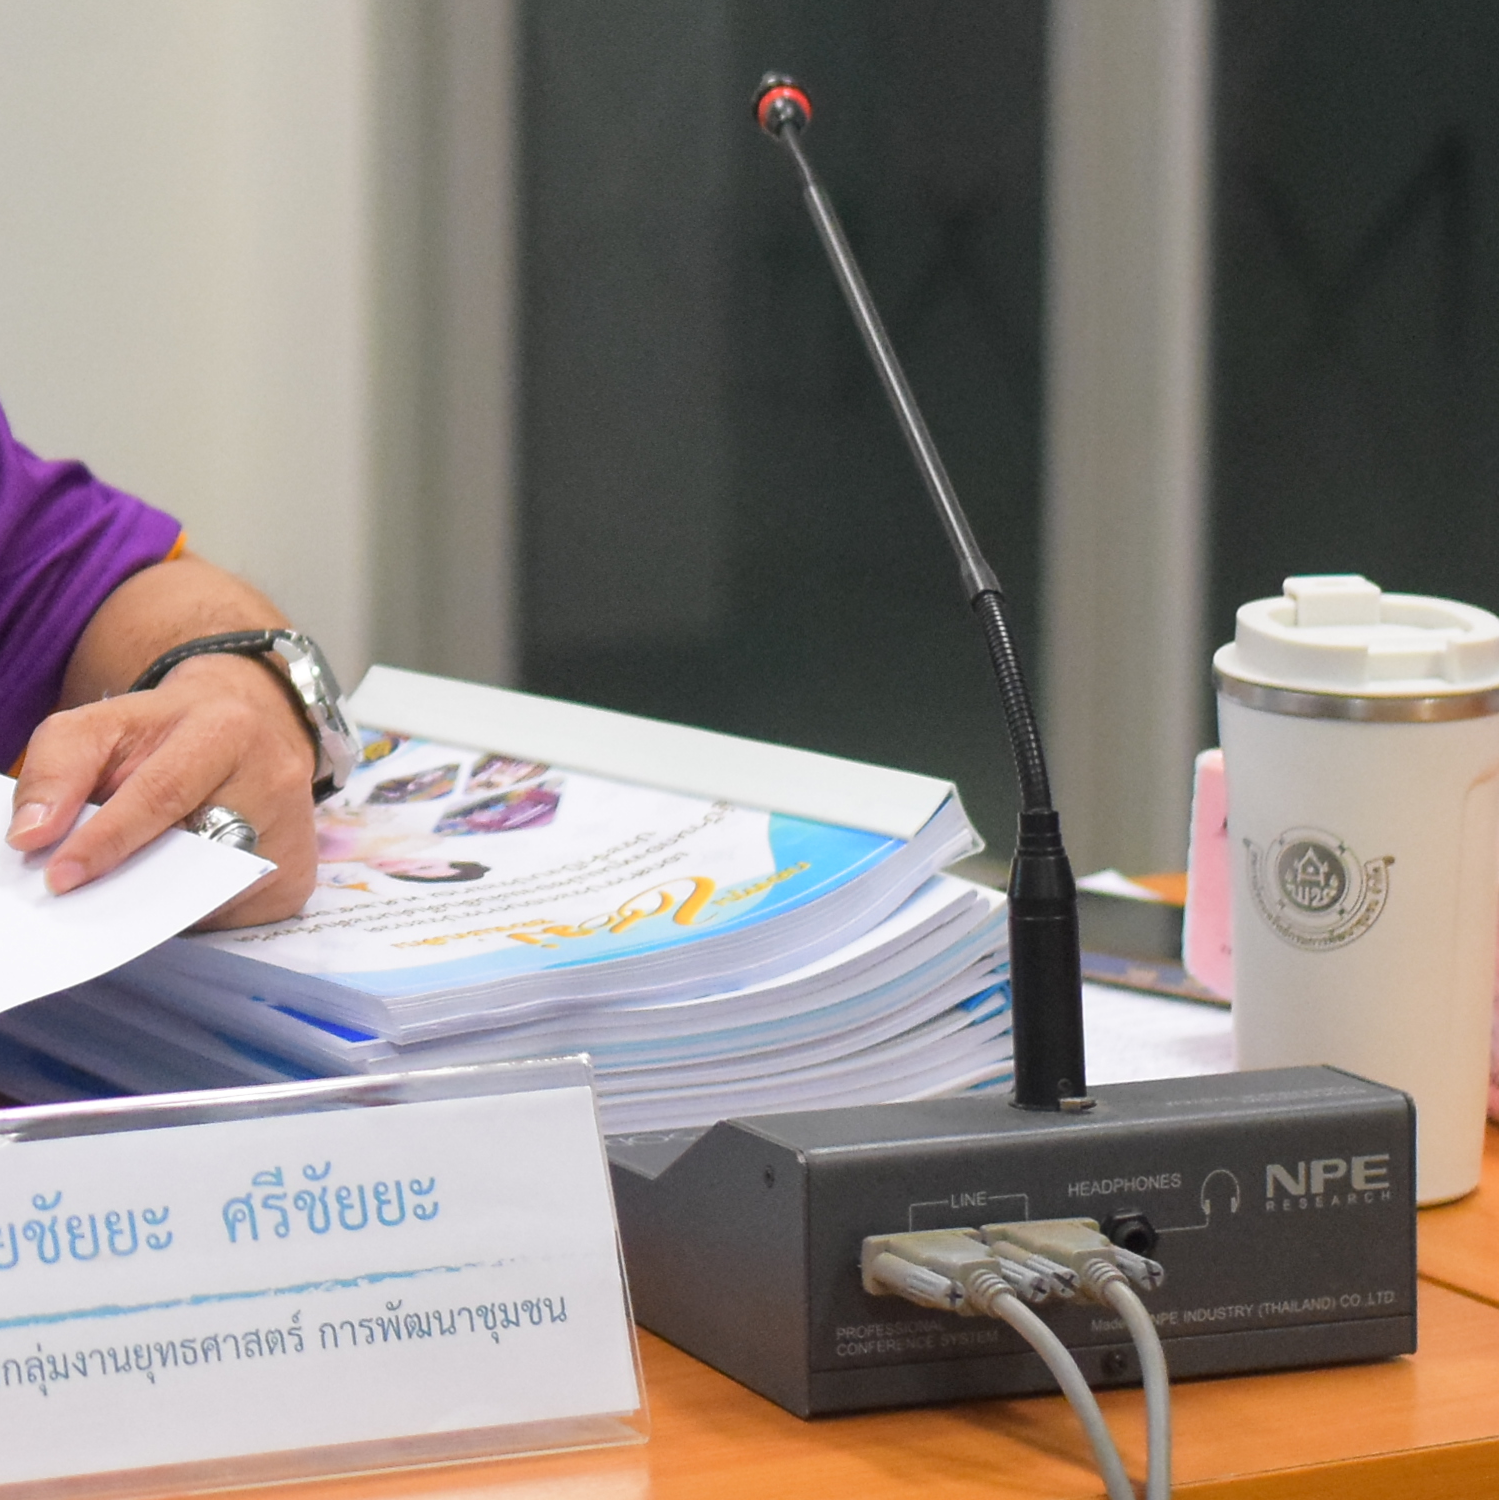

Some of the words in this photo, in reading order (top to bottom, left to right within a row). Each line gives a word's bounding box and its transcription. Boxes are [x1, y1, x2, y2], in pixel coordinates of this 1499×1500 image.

[1068, 1173, 1182, 1197] HEADPHONES
[1266, 1154, 1391, 1198] NPE
[223, 1161, 441, 1245] ศรีชัยยะ
[951, 1190, 987, 1210] LINE
[1266, 1190, 1391, 1211] RESEARCH
[1184, 1304, 1253, 1324] INDUSTRY
[1258, 1296, 1335, 1318] (THAILAND)
[316, 1289, 568, 1362] การพัฒนาชุมชน
[836, 1320, 944, 1340] PROFESSIONAL
[837, 1334, 935, 1357] CONFERENCE
[940, 1330, 998, 1347] SYSTEM
